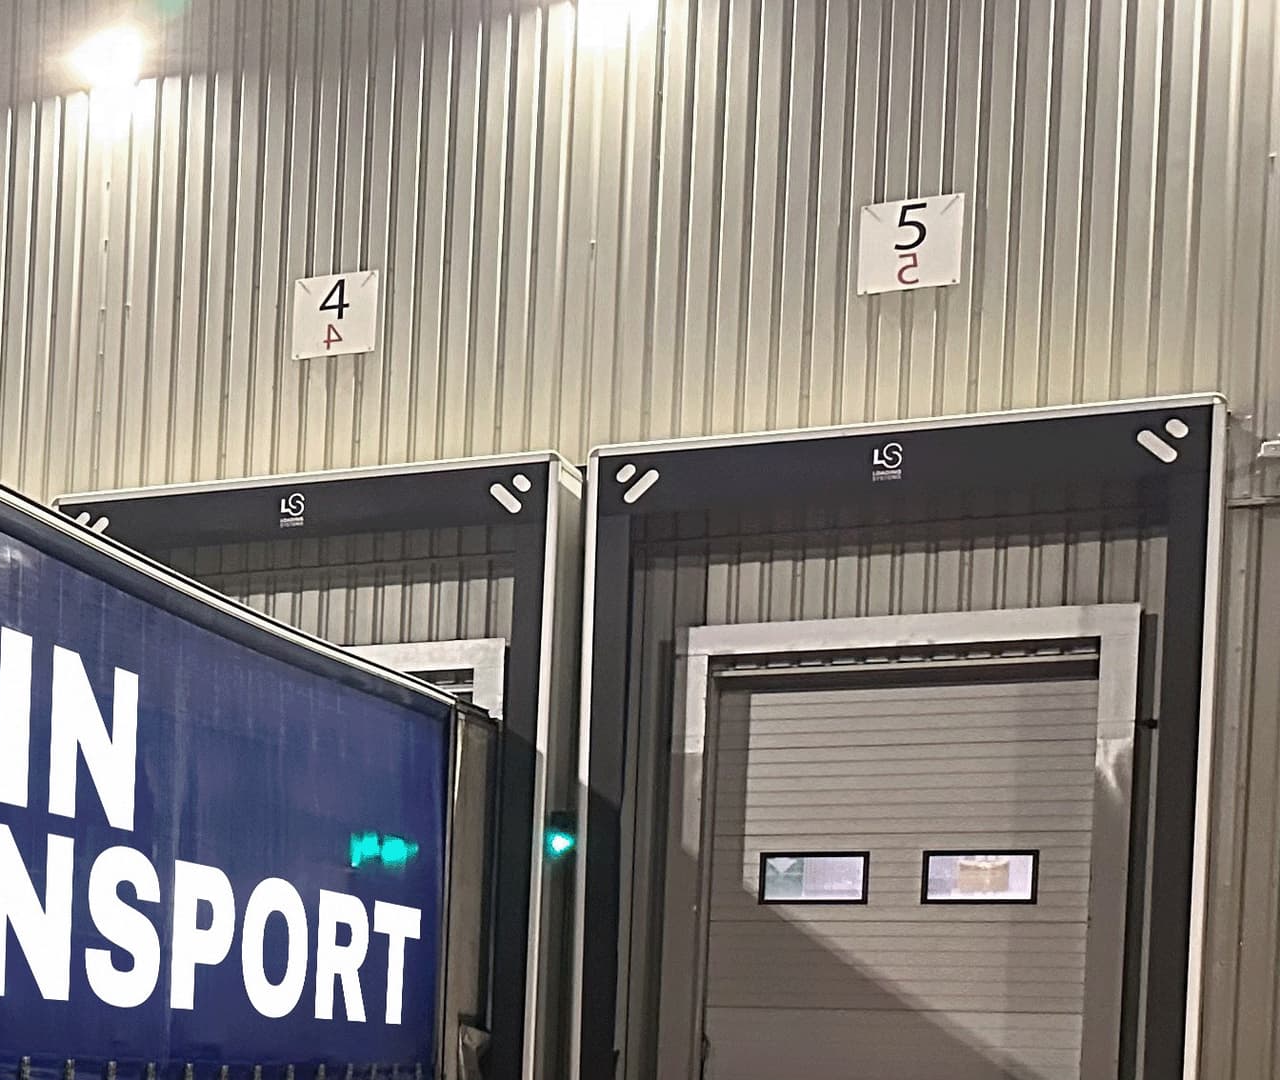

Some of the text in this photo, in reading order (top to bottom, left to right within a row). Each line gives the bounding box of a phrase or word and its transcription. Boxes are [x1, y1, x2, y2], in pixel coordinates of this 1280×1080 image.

[894, 202, 927, 250] 5
[319, 279, 350, 320] 4
[873, 442, 902, 469] LS
[281, 492, 305, 516] LS
